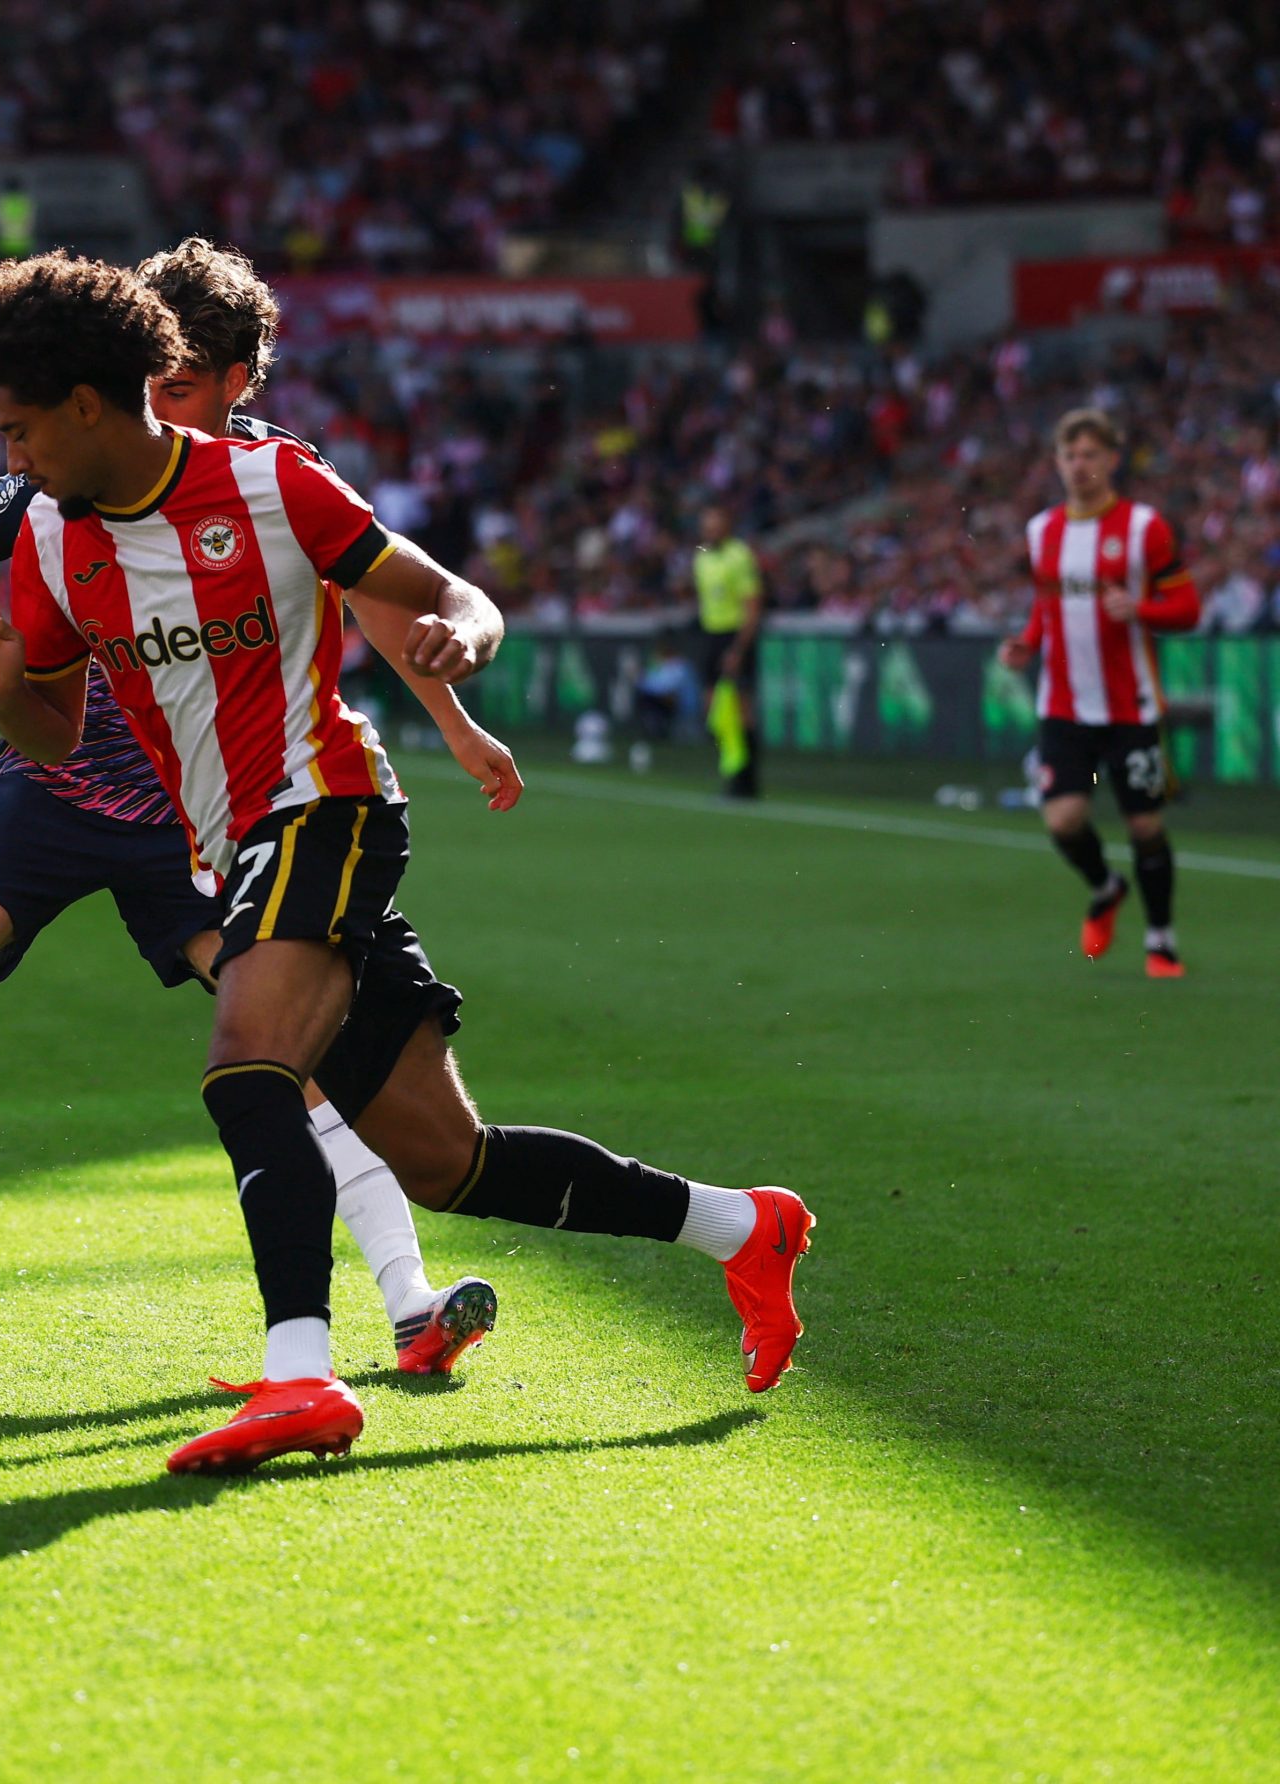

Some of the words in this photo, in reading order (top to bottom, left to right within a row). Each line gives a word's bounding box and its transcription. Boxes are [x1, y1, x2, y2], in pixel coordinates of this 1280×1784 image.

[195, 517, 233, 536] BRENTFORD
[81, 595, 275, 673] indeed
[231, 841, 276, 911] 7
